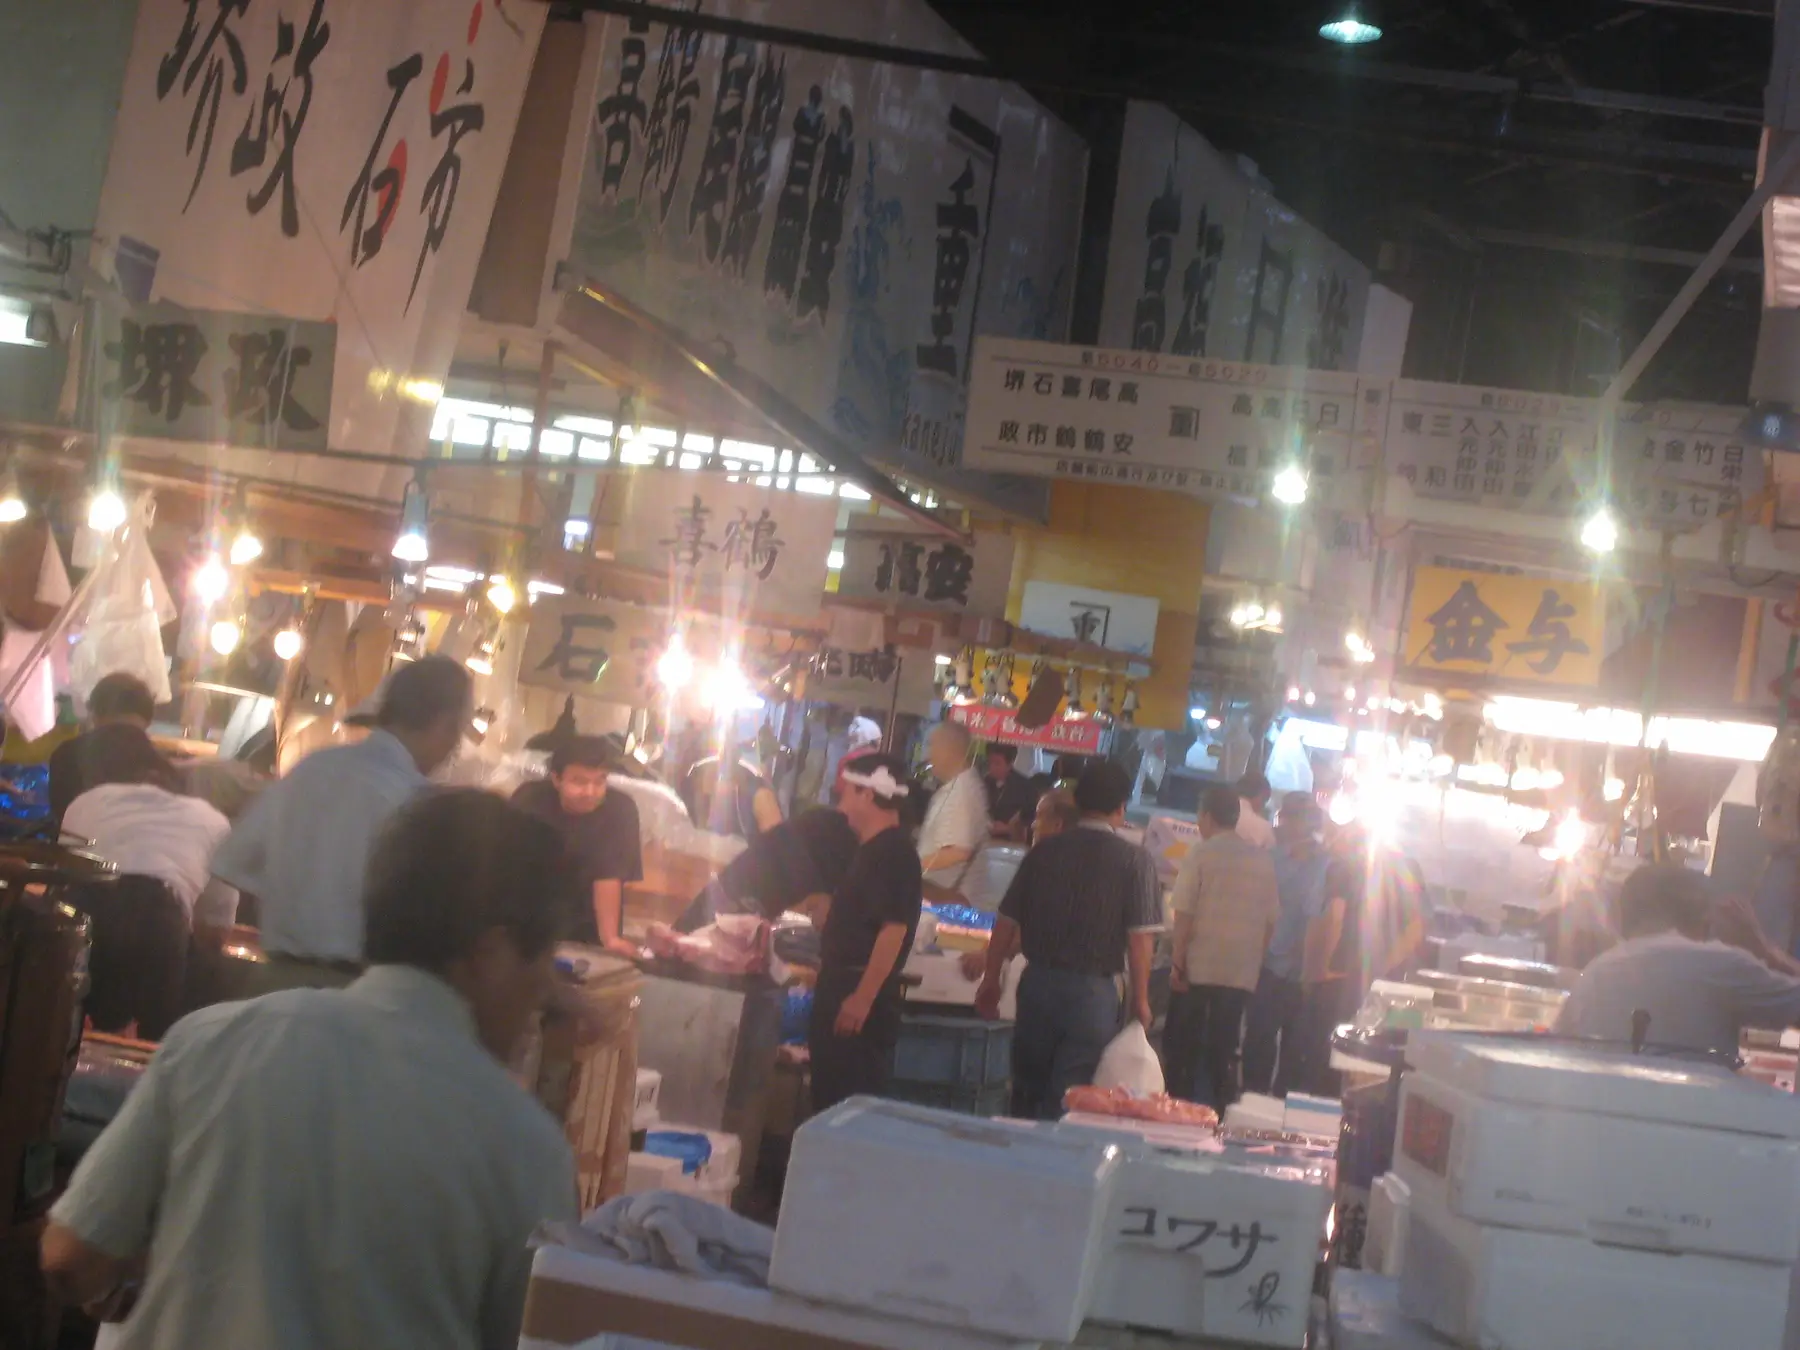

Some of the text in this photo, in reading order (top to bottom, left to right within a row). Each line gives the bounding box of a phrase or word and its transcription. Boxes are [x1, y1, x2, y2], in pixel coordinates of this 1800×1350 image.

[103, 317, 322, 432] 堺政
[658, 491, 787, 581] 喜鶴
[1423, 579, 1591, 675] 金与
